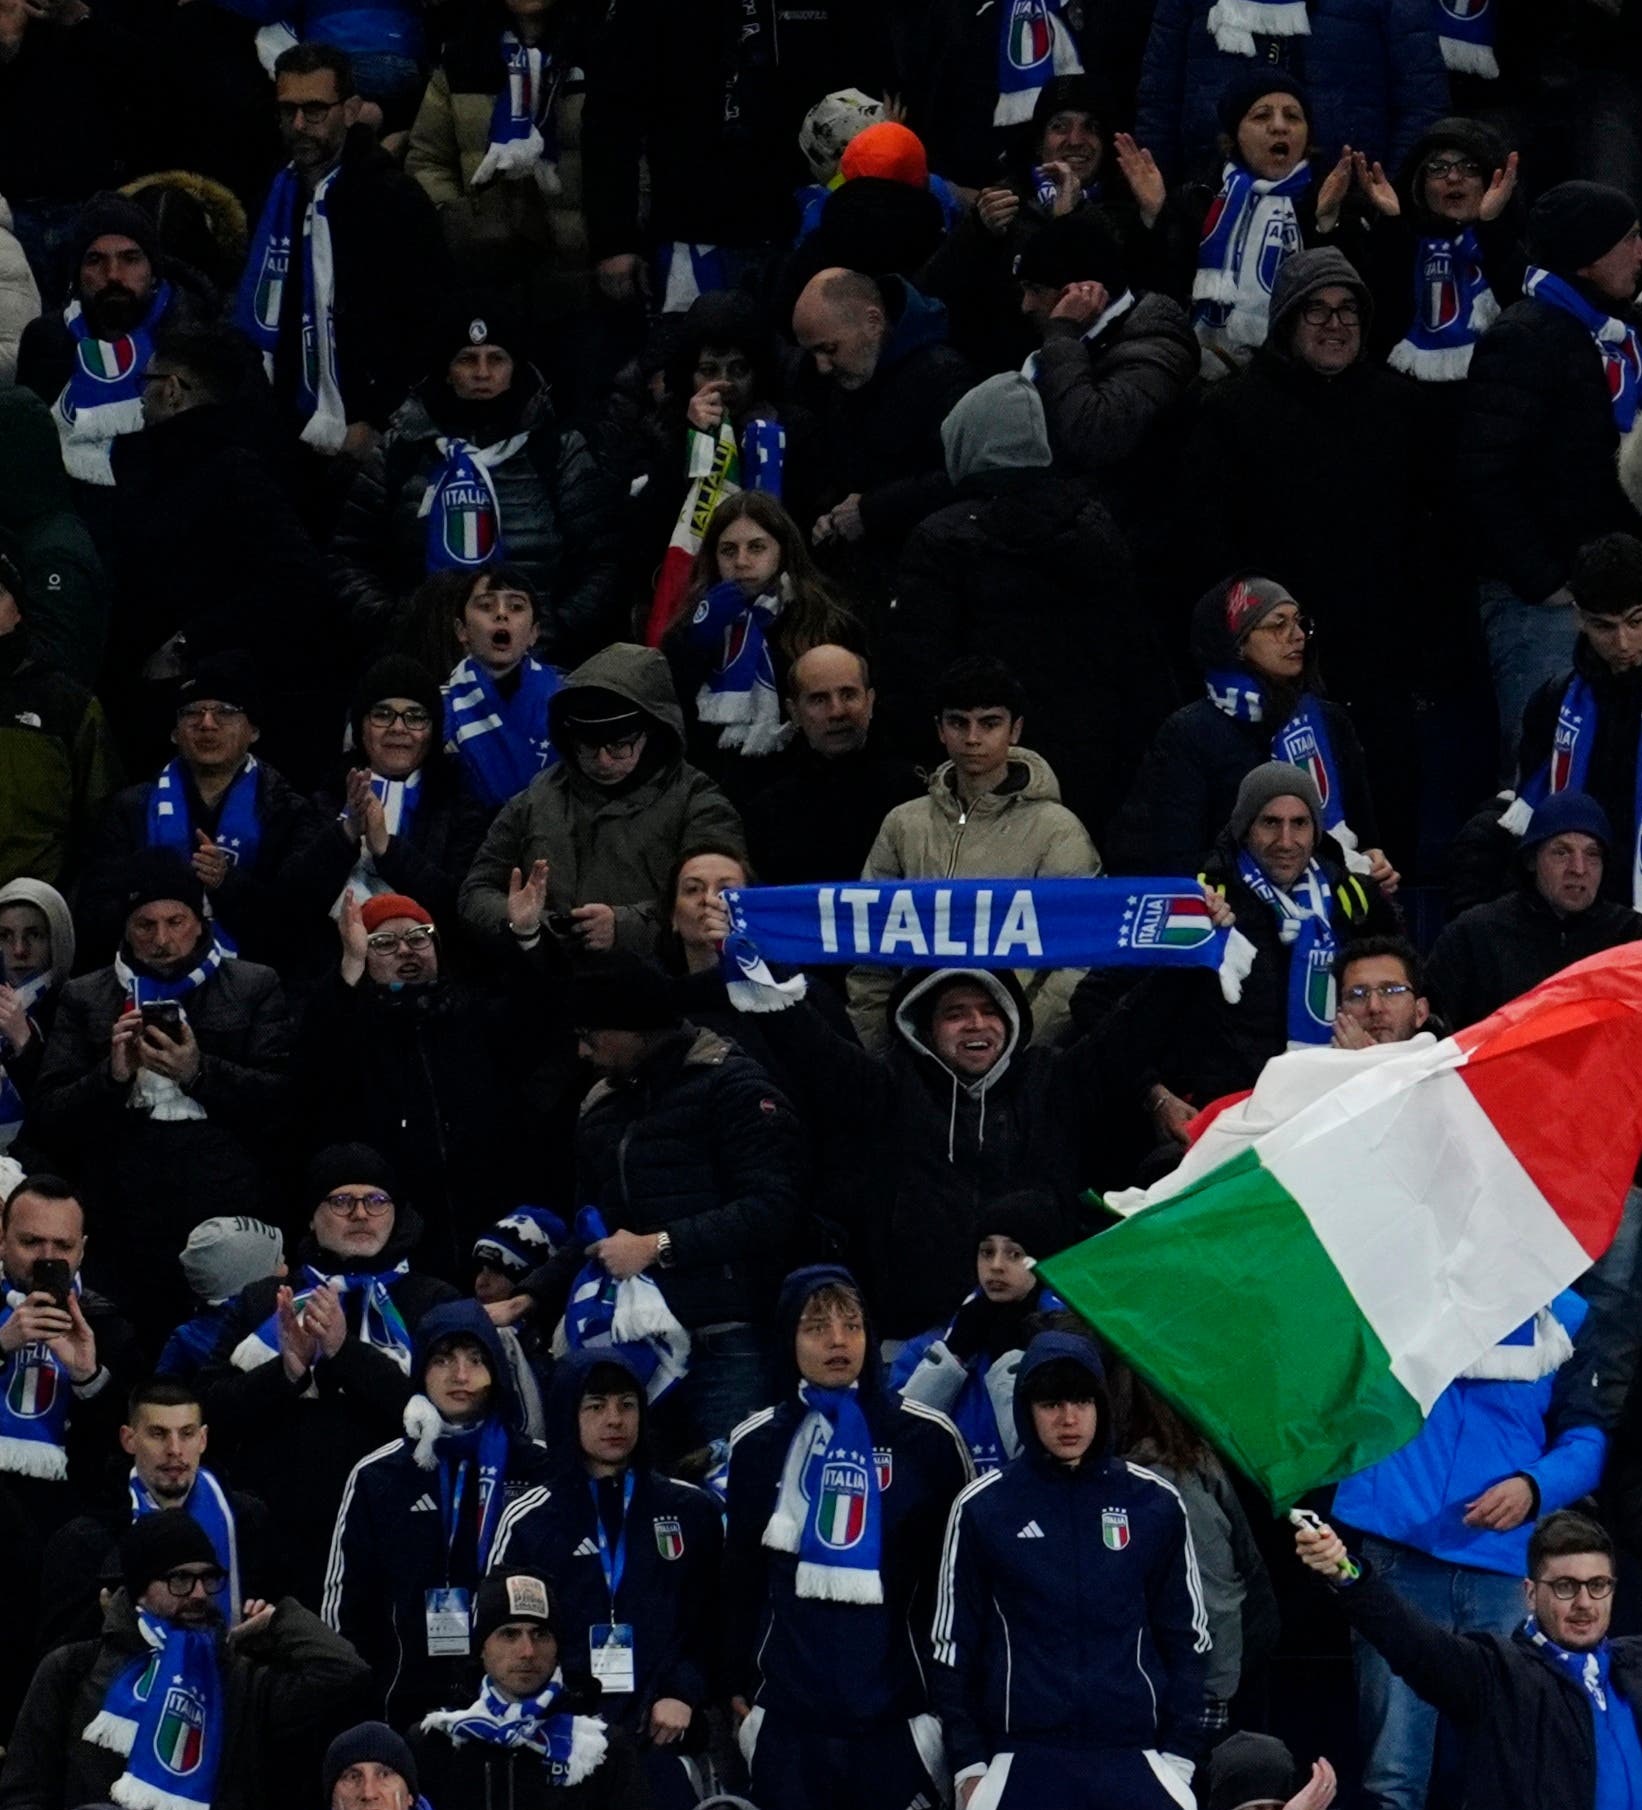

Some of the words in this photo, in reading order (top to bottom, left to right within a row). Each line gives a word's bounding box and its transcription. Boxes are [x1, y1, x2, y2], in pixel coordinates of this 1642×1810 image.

[445, 487, 492, 506] ITALIA
[816, 886, 1045, 957] ITALIA
[1136, 896, 1165, 945] ITALIA
[827, 1469, 864, 1488] ITALIA
[167, 1691, 203, 1722] ITALIA
